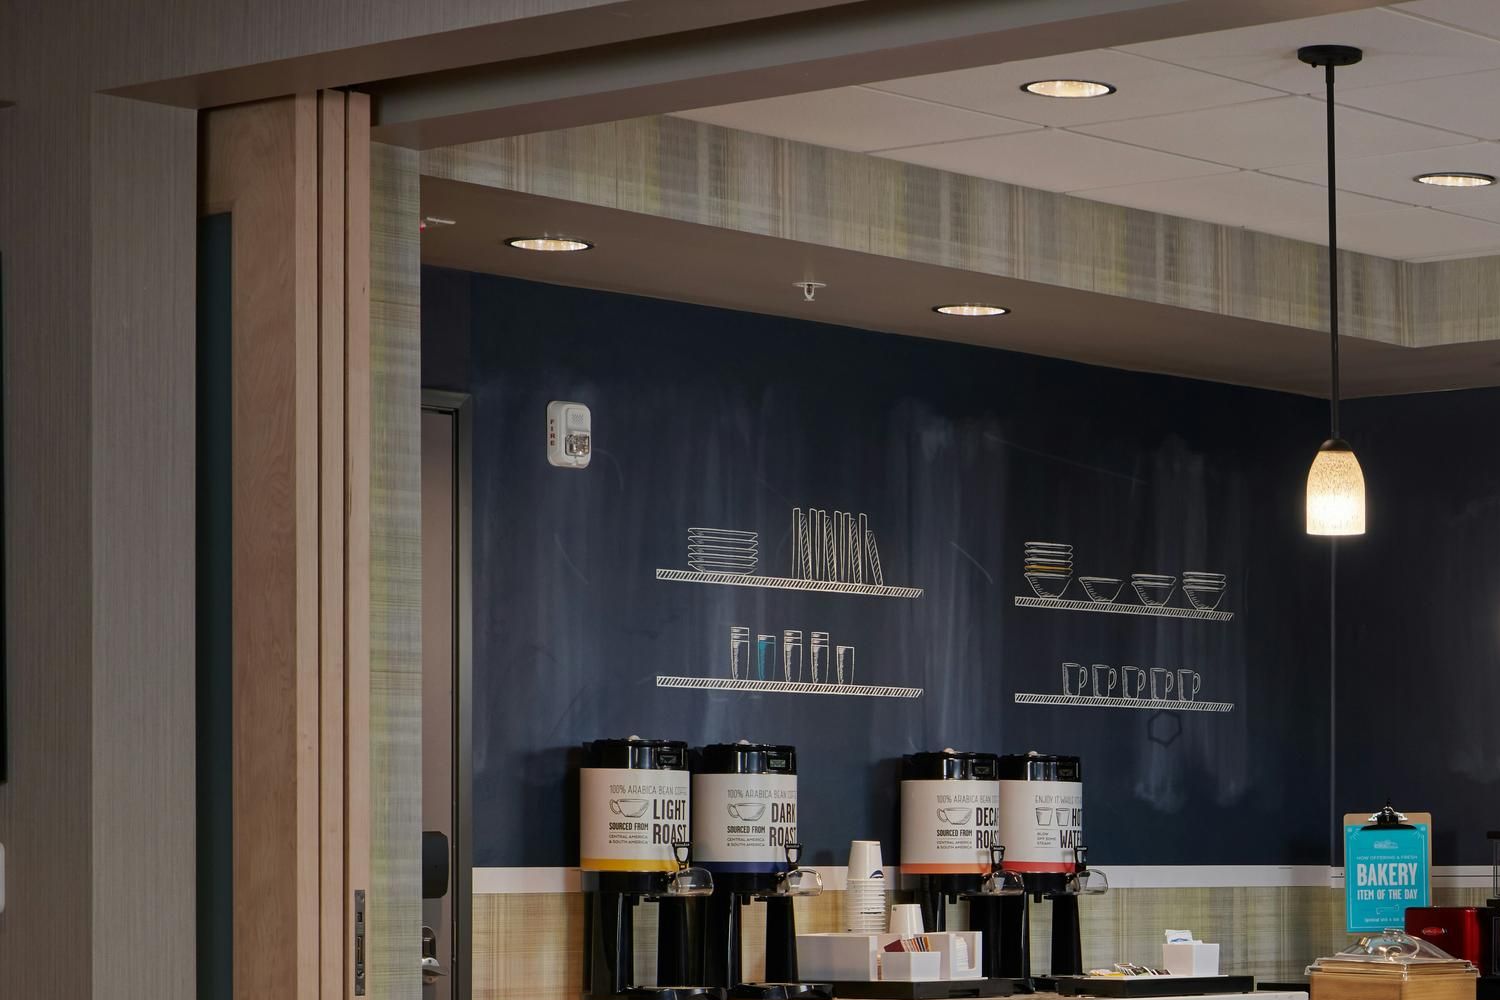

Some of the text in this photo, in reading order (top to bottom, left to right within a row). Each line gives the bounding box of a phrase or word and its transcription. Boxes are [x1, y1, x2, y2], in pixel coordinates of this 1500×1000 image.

[609, 785, 627, 795] 100%
[627, 785, 657, 795] ARABICA
[658, 786, 674, 796] BEAN
[727, 789, 744, 799] 100%
[745, 789, 773, 799] ARABICA
[936, 794, 953, 804] 100%
[953, 794, 979, 804] ARABICA
[1035, 794, 1053, 804] ENJOY
[652, 799, 687, 821] LIGHT
[771, 802, 796, 823] DARK
[1071, 807, 1082, 827] HO
[608, 822, 649, 831] SOURCED FROM
[727, 825, 766, 834] SOURCED FROM
[652, 823, 688, 845] ROAST
[936, 829, 973, 837] SOURCED FROM
[1356, 862, 1418, 887] BAKERY
[1357, 888, 1419, 901] ITEM OF THE DAY
